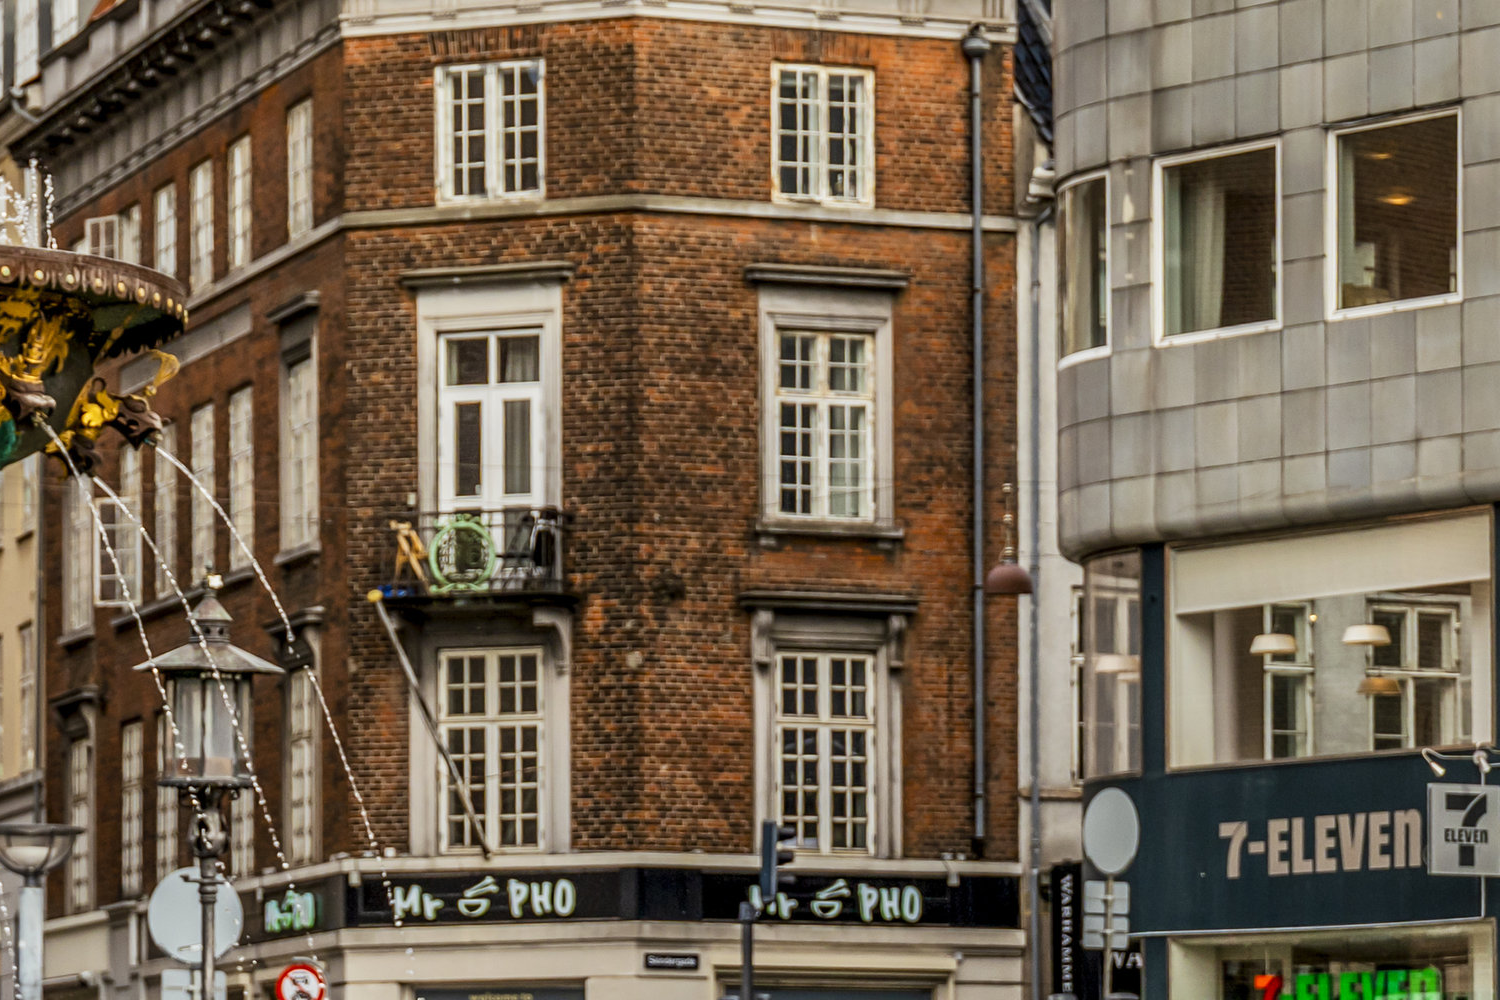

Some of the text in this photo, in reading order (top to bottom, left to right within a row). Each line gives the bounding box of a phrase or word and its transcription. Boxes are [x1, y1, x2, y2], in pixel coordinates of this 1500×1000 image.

[393, 878, 577, 921] Mr PHO
[857, 883, 923, 924] PHO
